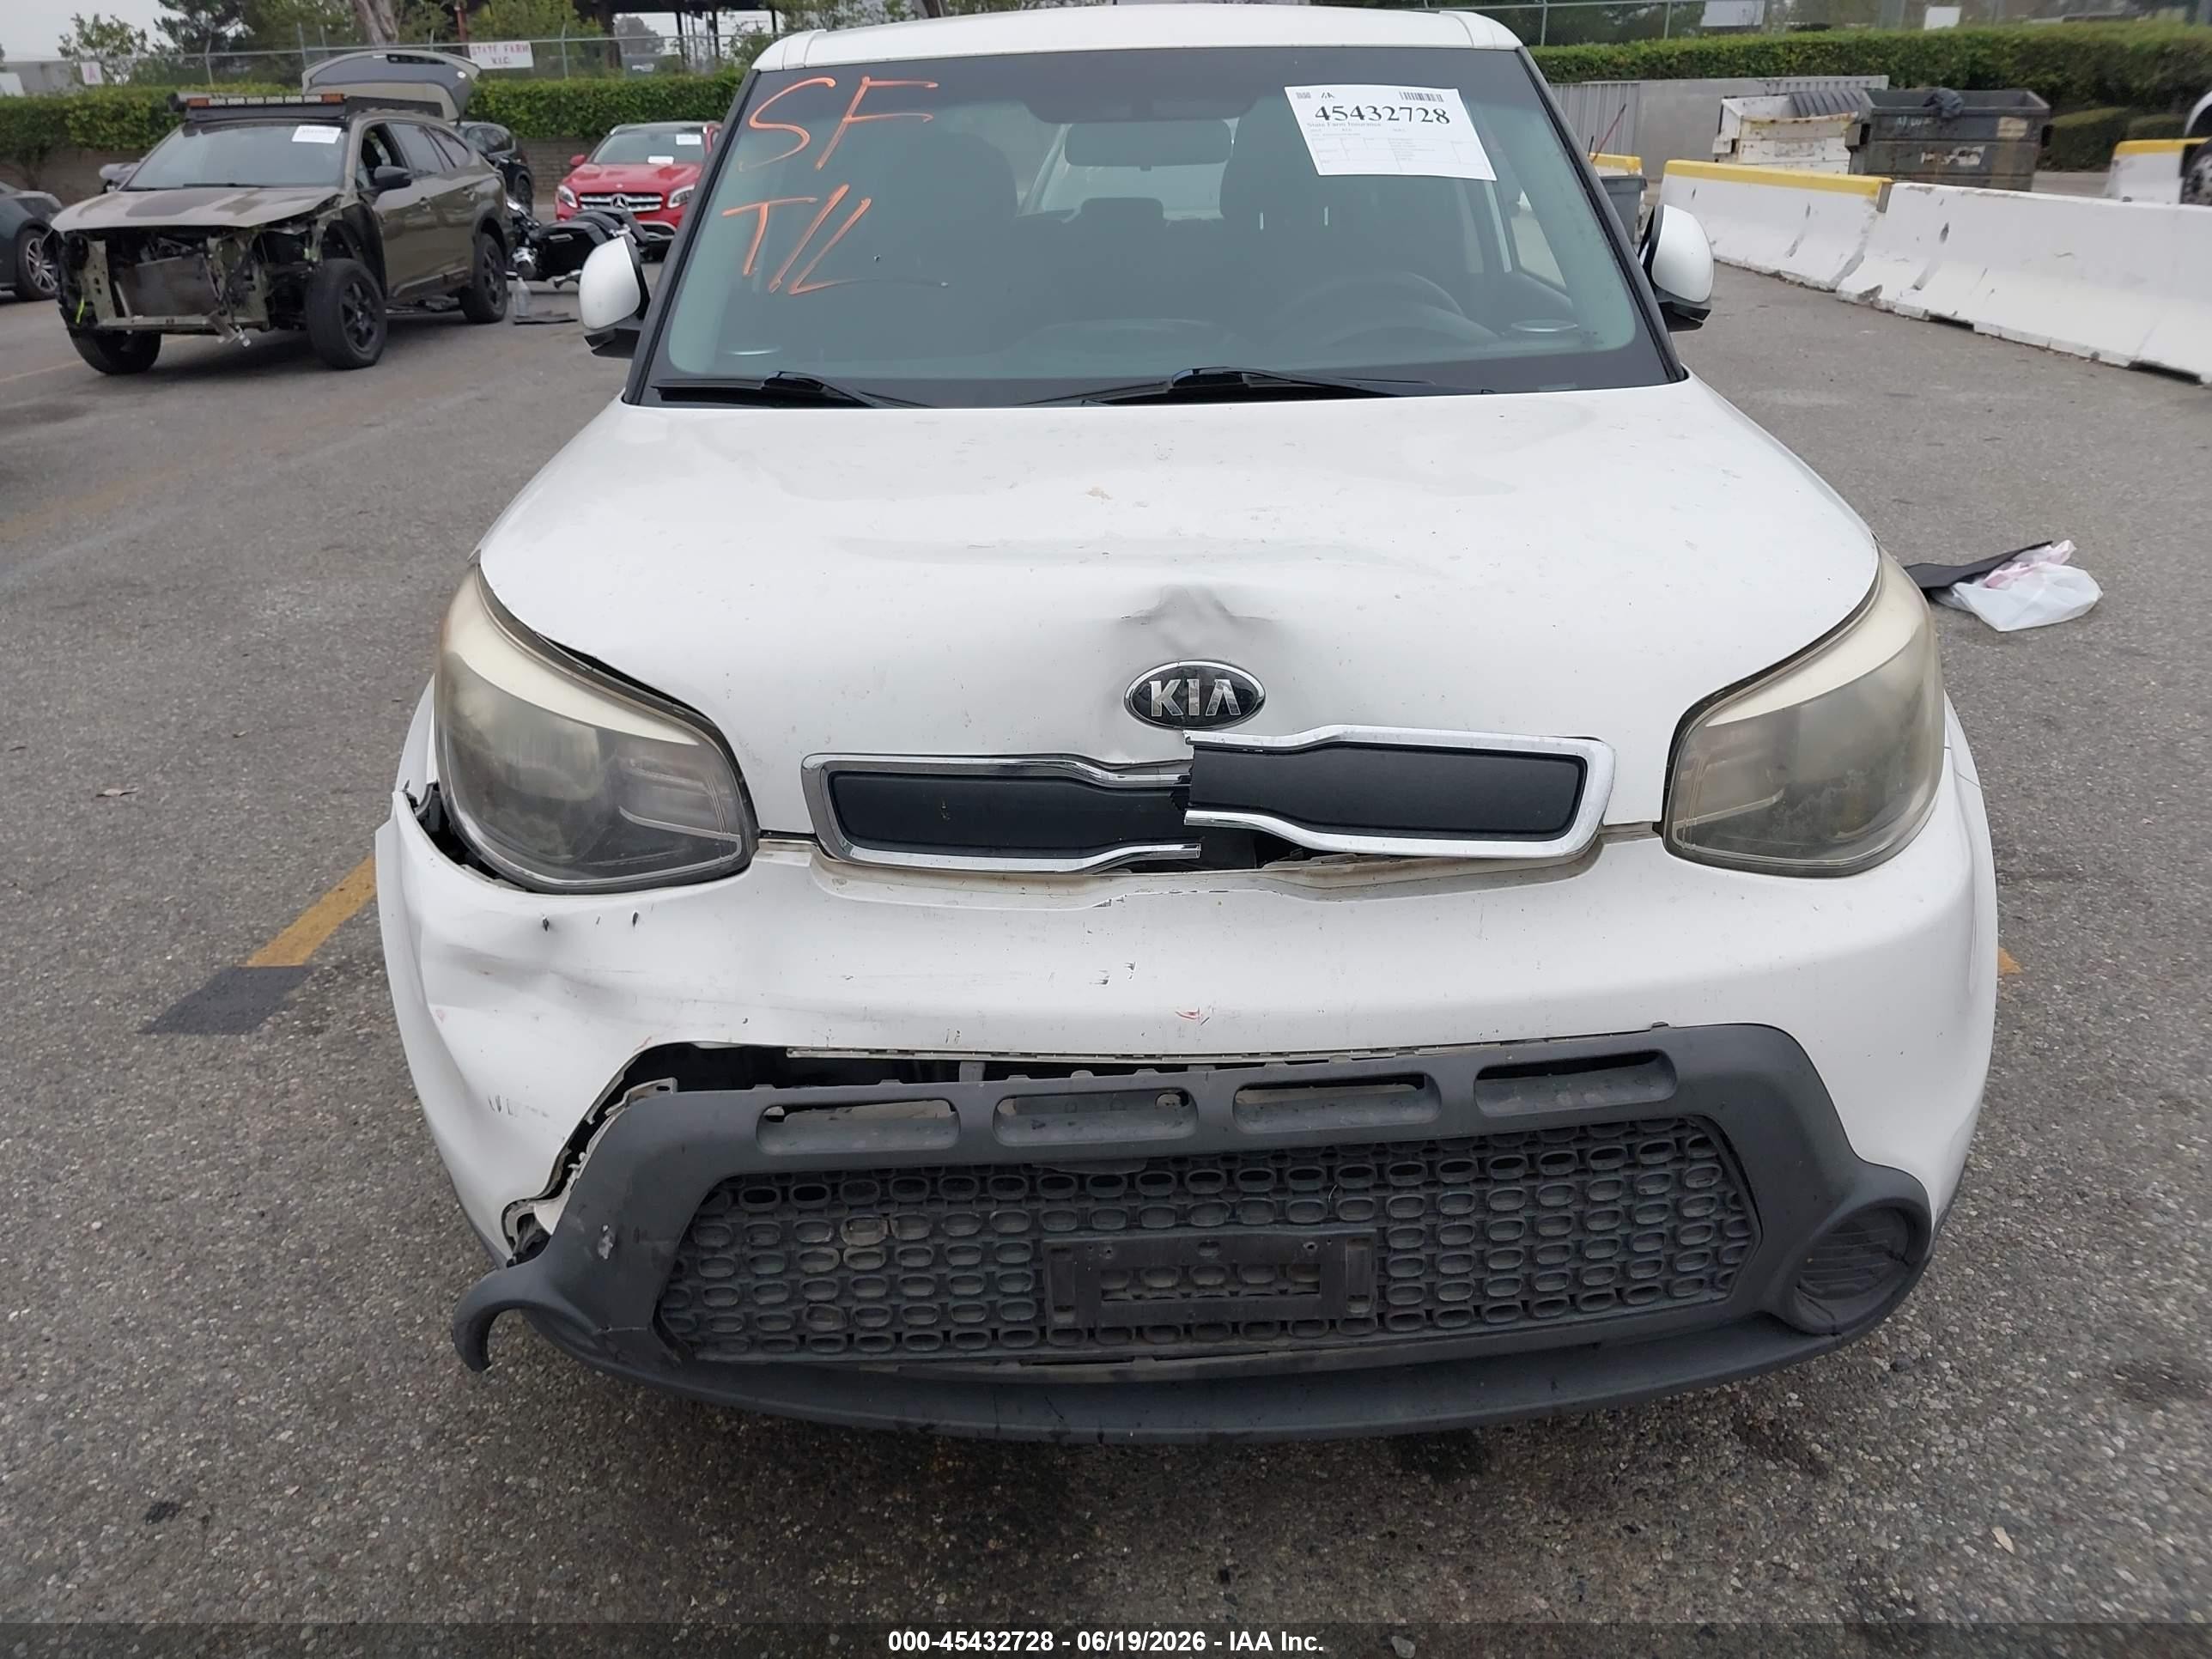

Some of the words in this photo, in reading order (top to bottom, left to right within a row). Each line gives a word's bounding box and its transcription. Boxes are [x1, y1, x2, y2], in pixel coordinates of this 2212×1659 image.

[471, 46, 497, 56] STATE
[503, 44, 530, 53] FARM
[738, 76, 939, 172] SF
[1315, 106, 1450, 125] 45432728
[1149, 678, 1241, 717] KIA
